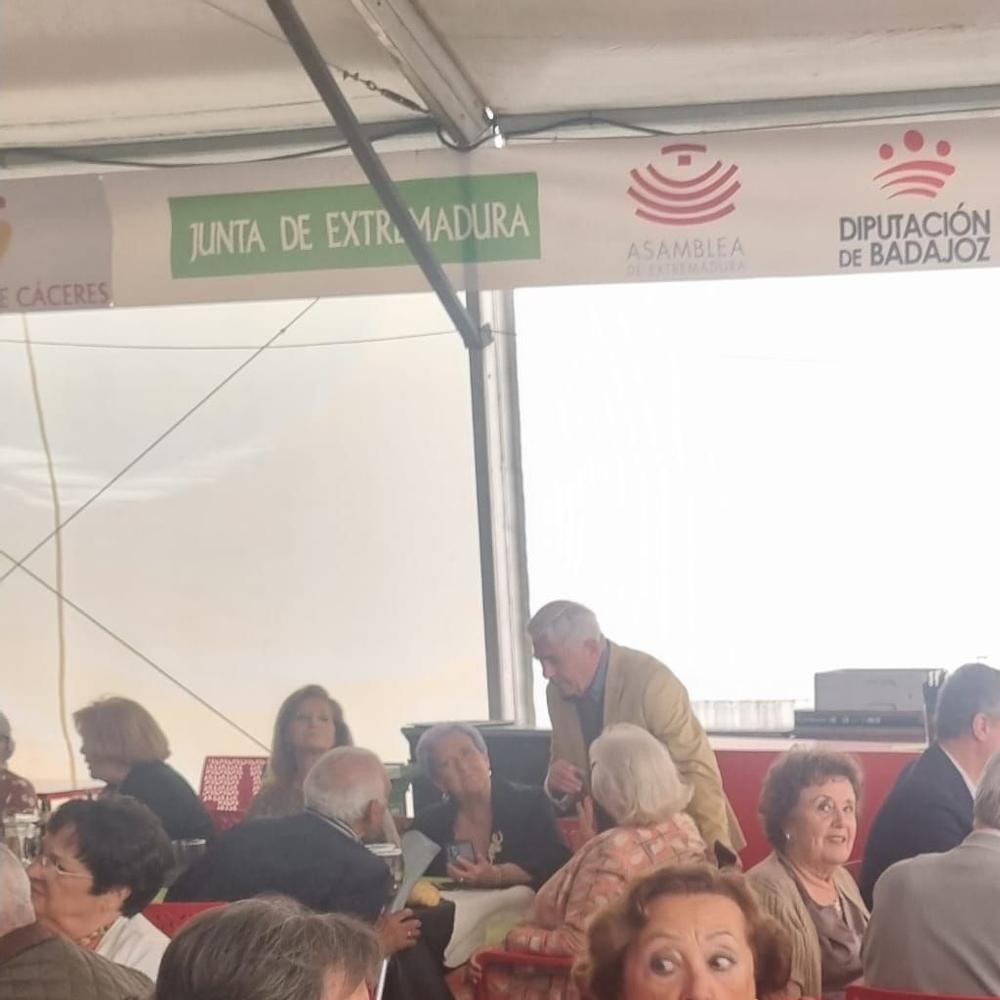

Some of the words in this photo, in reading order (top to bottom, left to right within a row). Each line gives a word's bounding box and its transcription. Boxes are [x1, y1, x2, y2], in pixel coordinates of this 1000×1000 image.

[839, 201, 991, 242] DIPUTACIÓN
[189, 220, 266, 262] JUNTA
[280, 213, 313, 251] DE
[626, 236, 745, 260] ASAMBLEA
[838, 248, 862, 268] DE
[870, 237, 991, 267] BADAJOZ
[16, 280, 110, 308] CÁCERES
